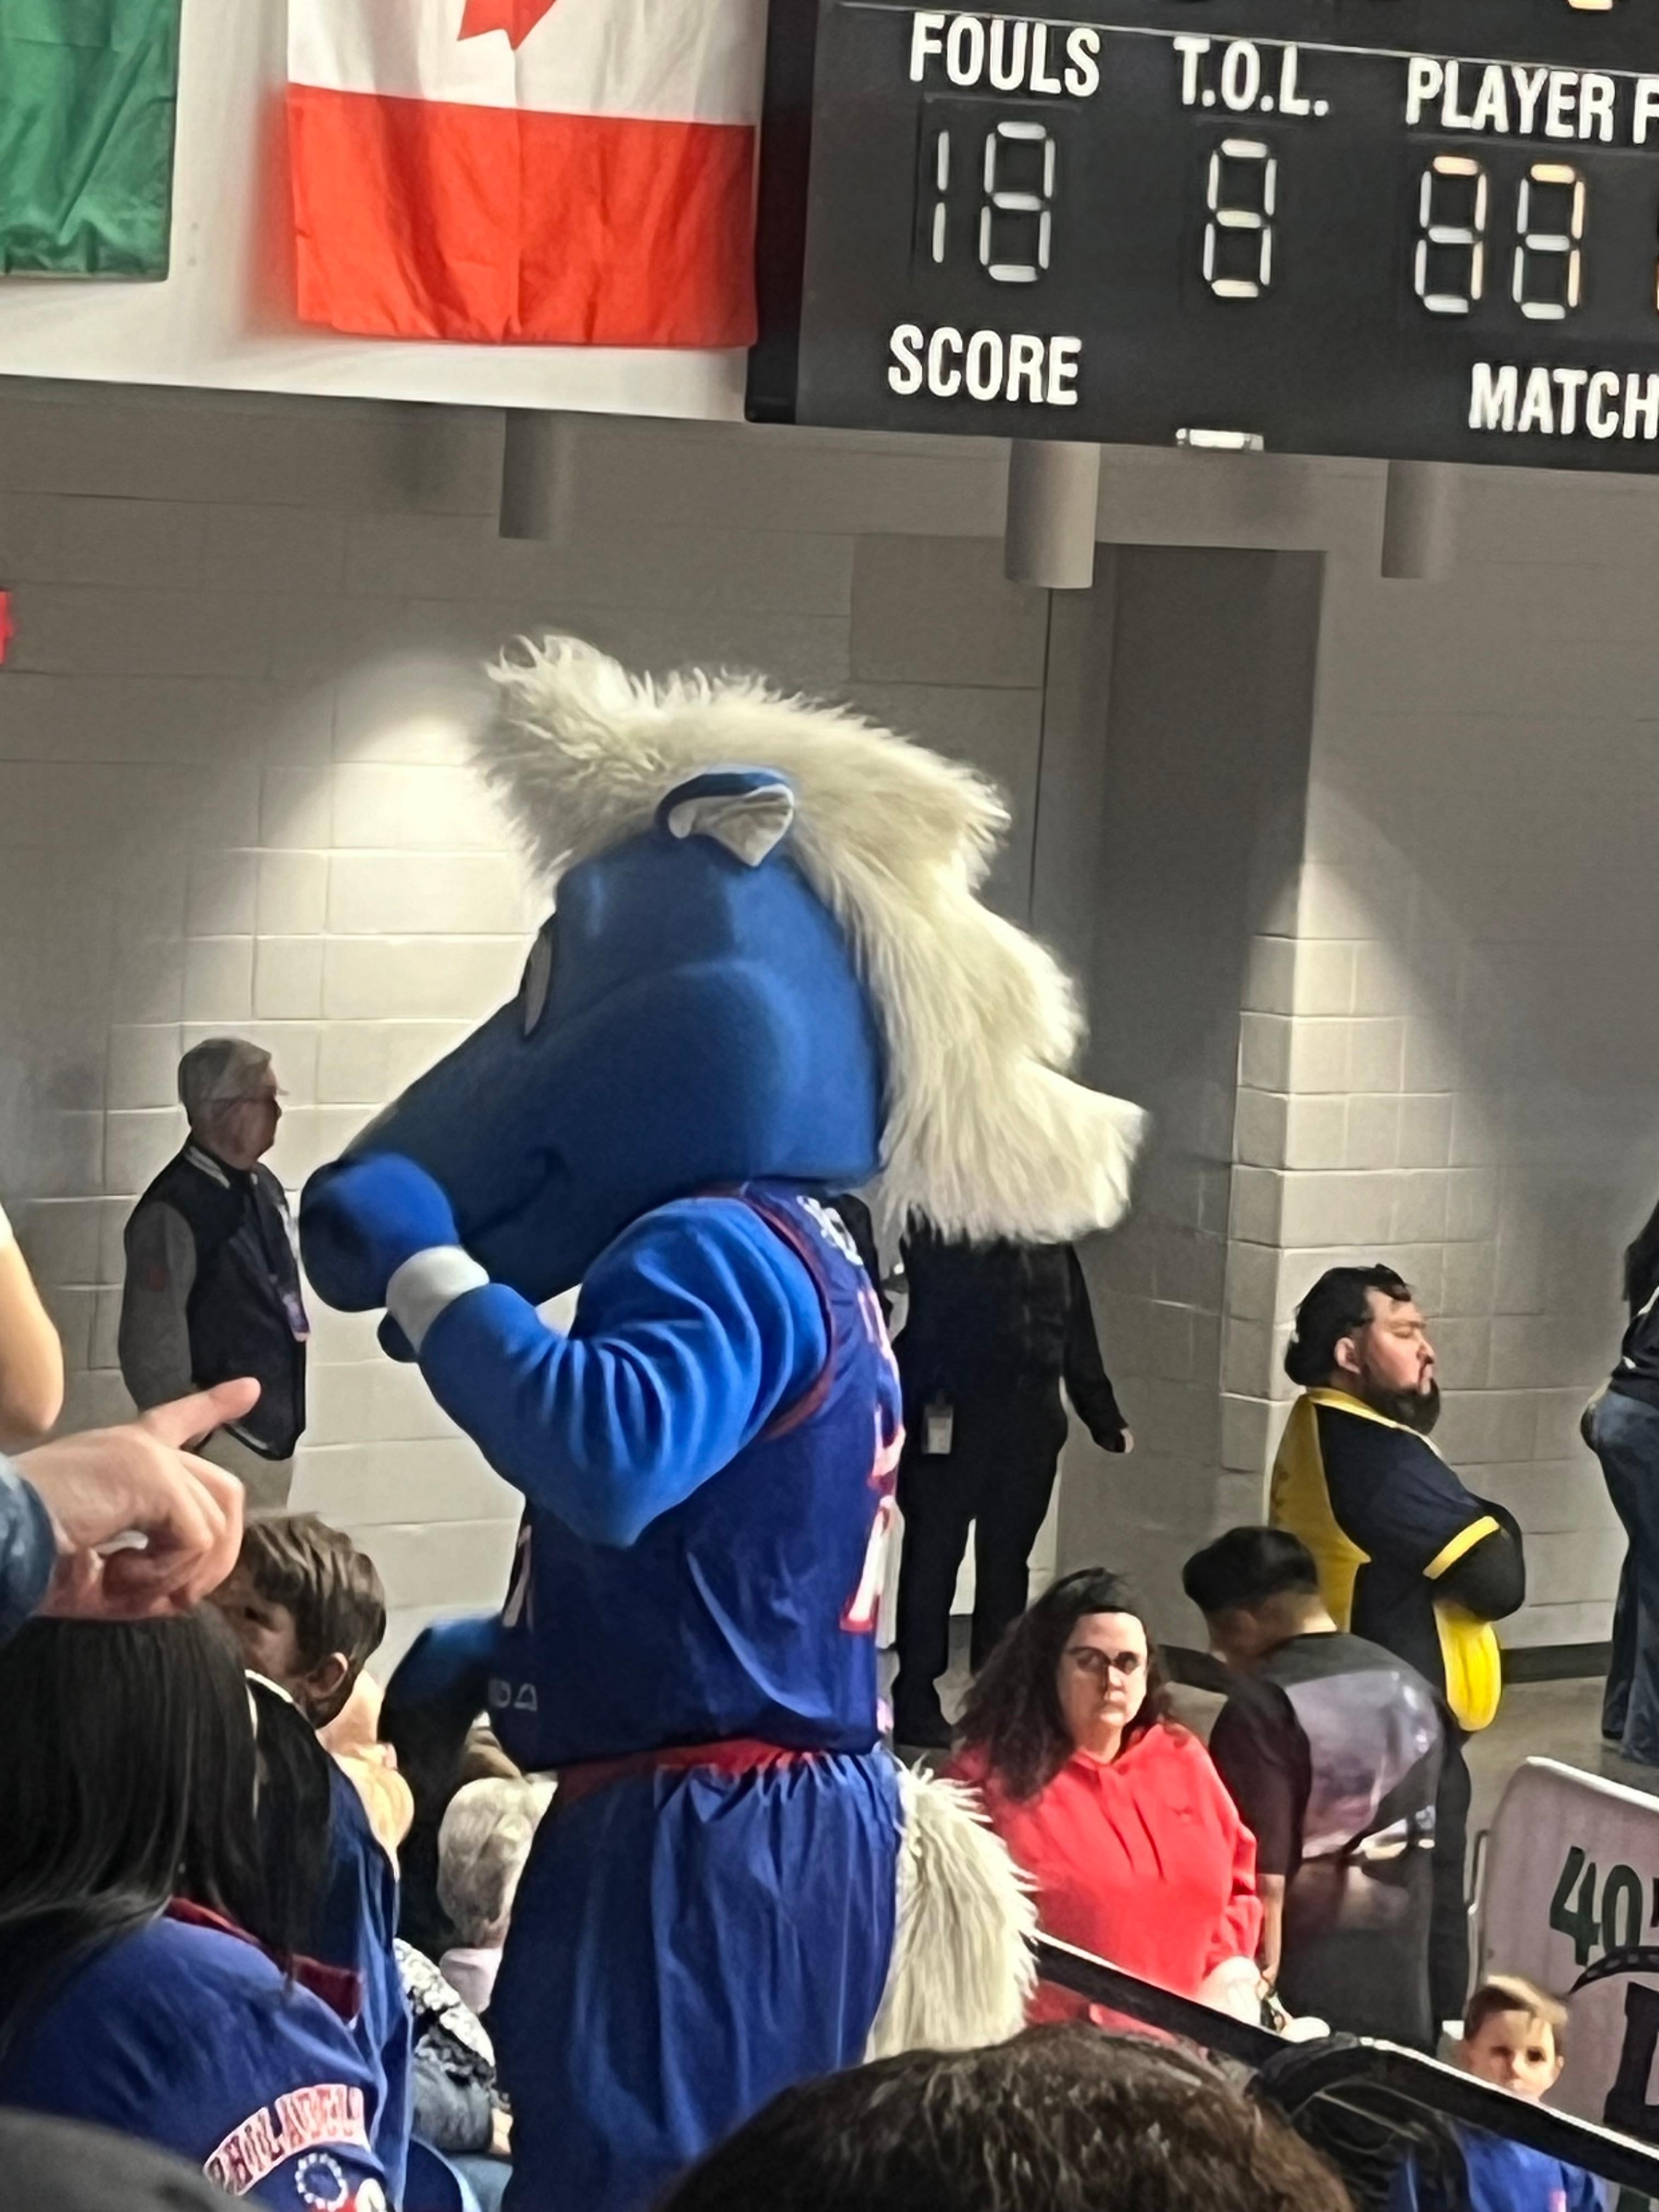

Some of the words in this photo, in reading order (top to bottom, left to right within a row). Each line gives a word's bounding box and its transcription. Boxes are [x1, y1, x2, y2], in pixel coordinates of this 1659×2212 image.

[910, 12, 1101, 98] FOULS
[1173, 36, 1329, 117] T.O.L.
[1405, 57, 1615, 143] PLAYER
[888, 324, 1082, 405] SCORE
[1468, 362, 1659, 439] MATCH
